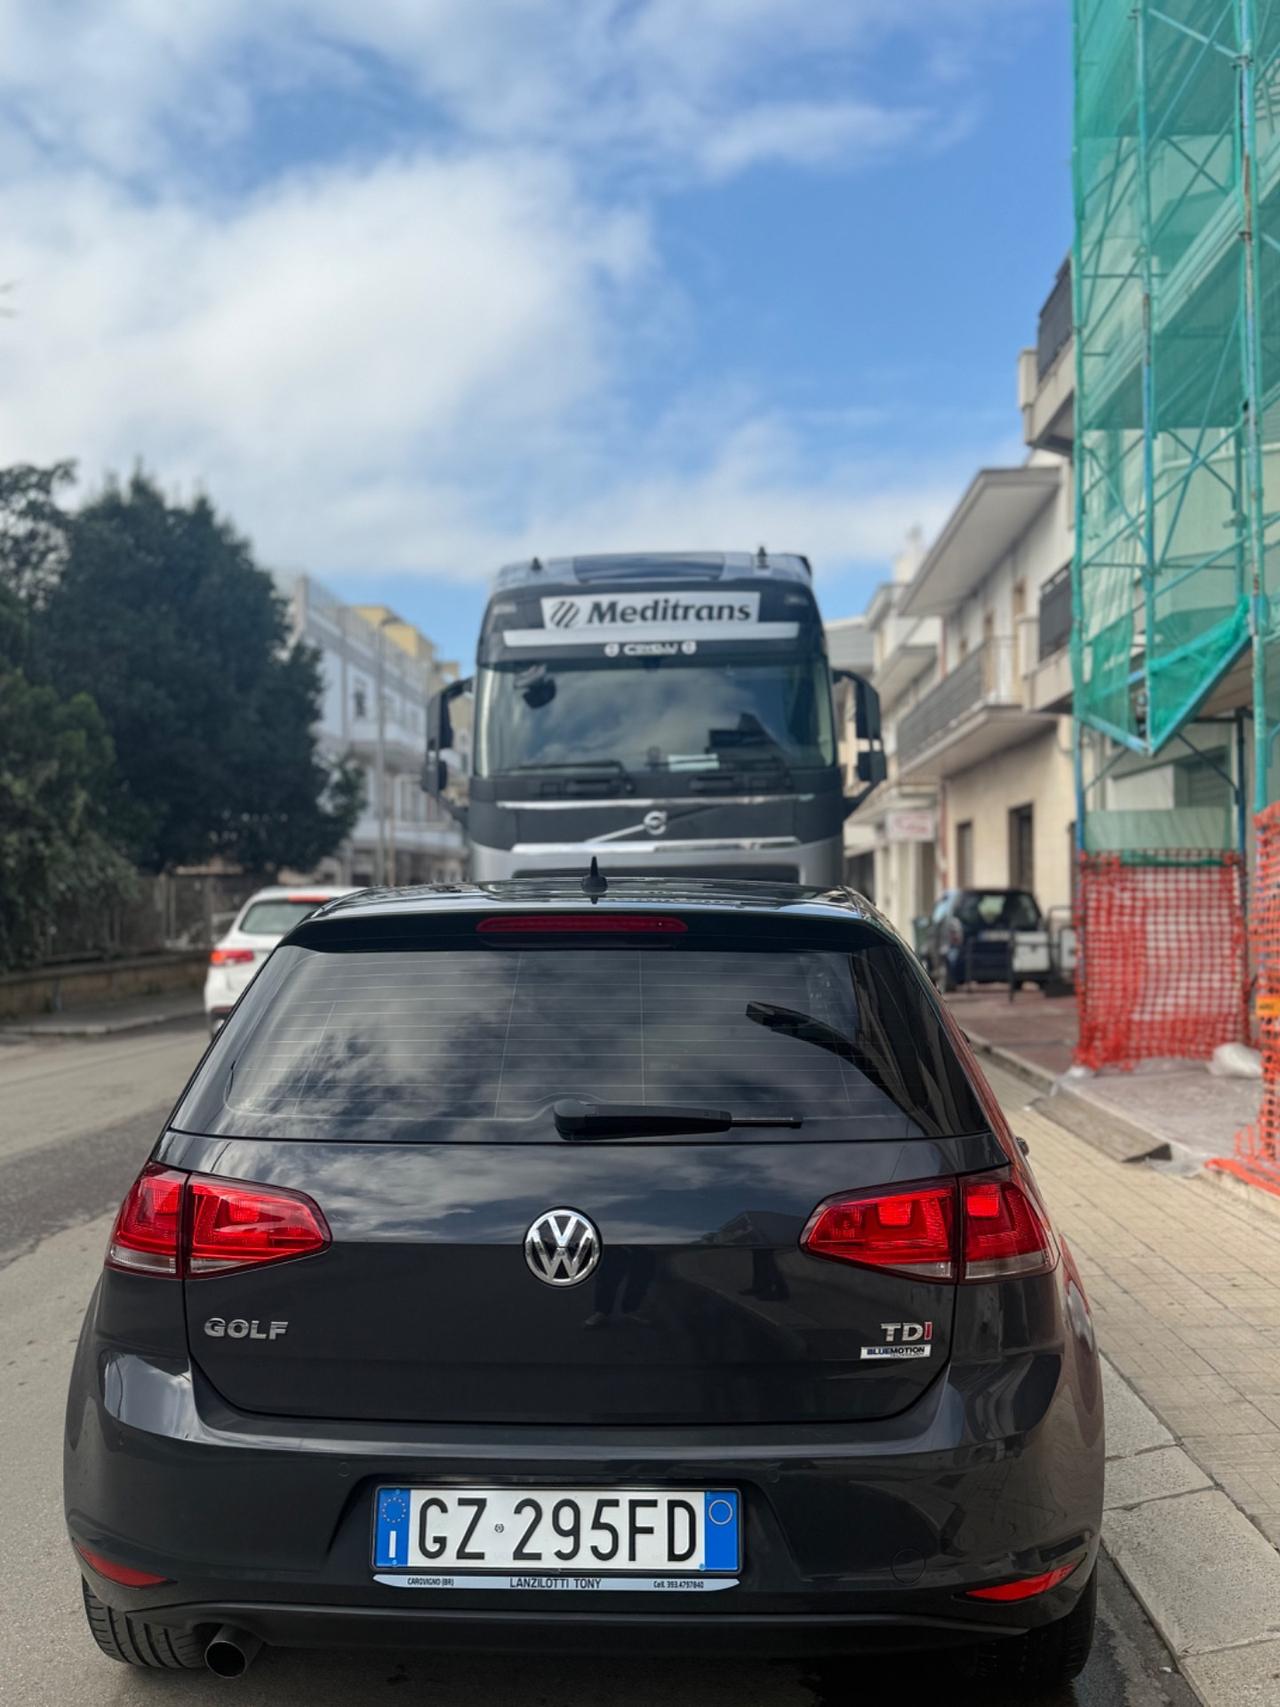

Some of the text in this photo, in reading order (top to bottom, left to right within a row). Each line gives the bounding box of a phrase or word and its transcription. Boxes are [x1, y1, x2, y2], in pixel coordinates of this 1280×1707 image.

[586, 598, 752, 625] Meditrans
[204, 1317, 289, 1340] GOLF
[880, 1321, 933, 1342] TDI
[867, 1346, 925, 1355] BLUEMOTION
[418, 1497, 697, 1562] GZ 295FD
[509, 1578, 602, 1589] LANZILOTTI TONY
